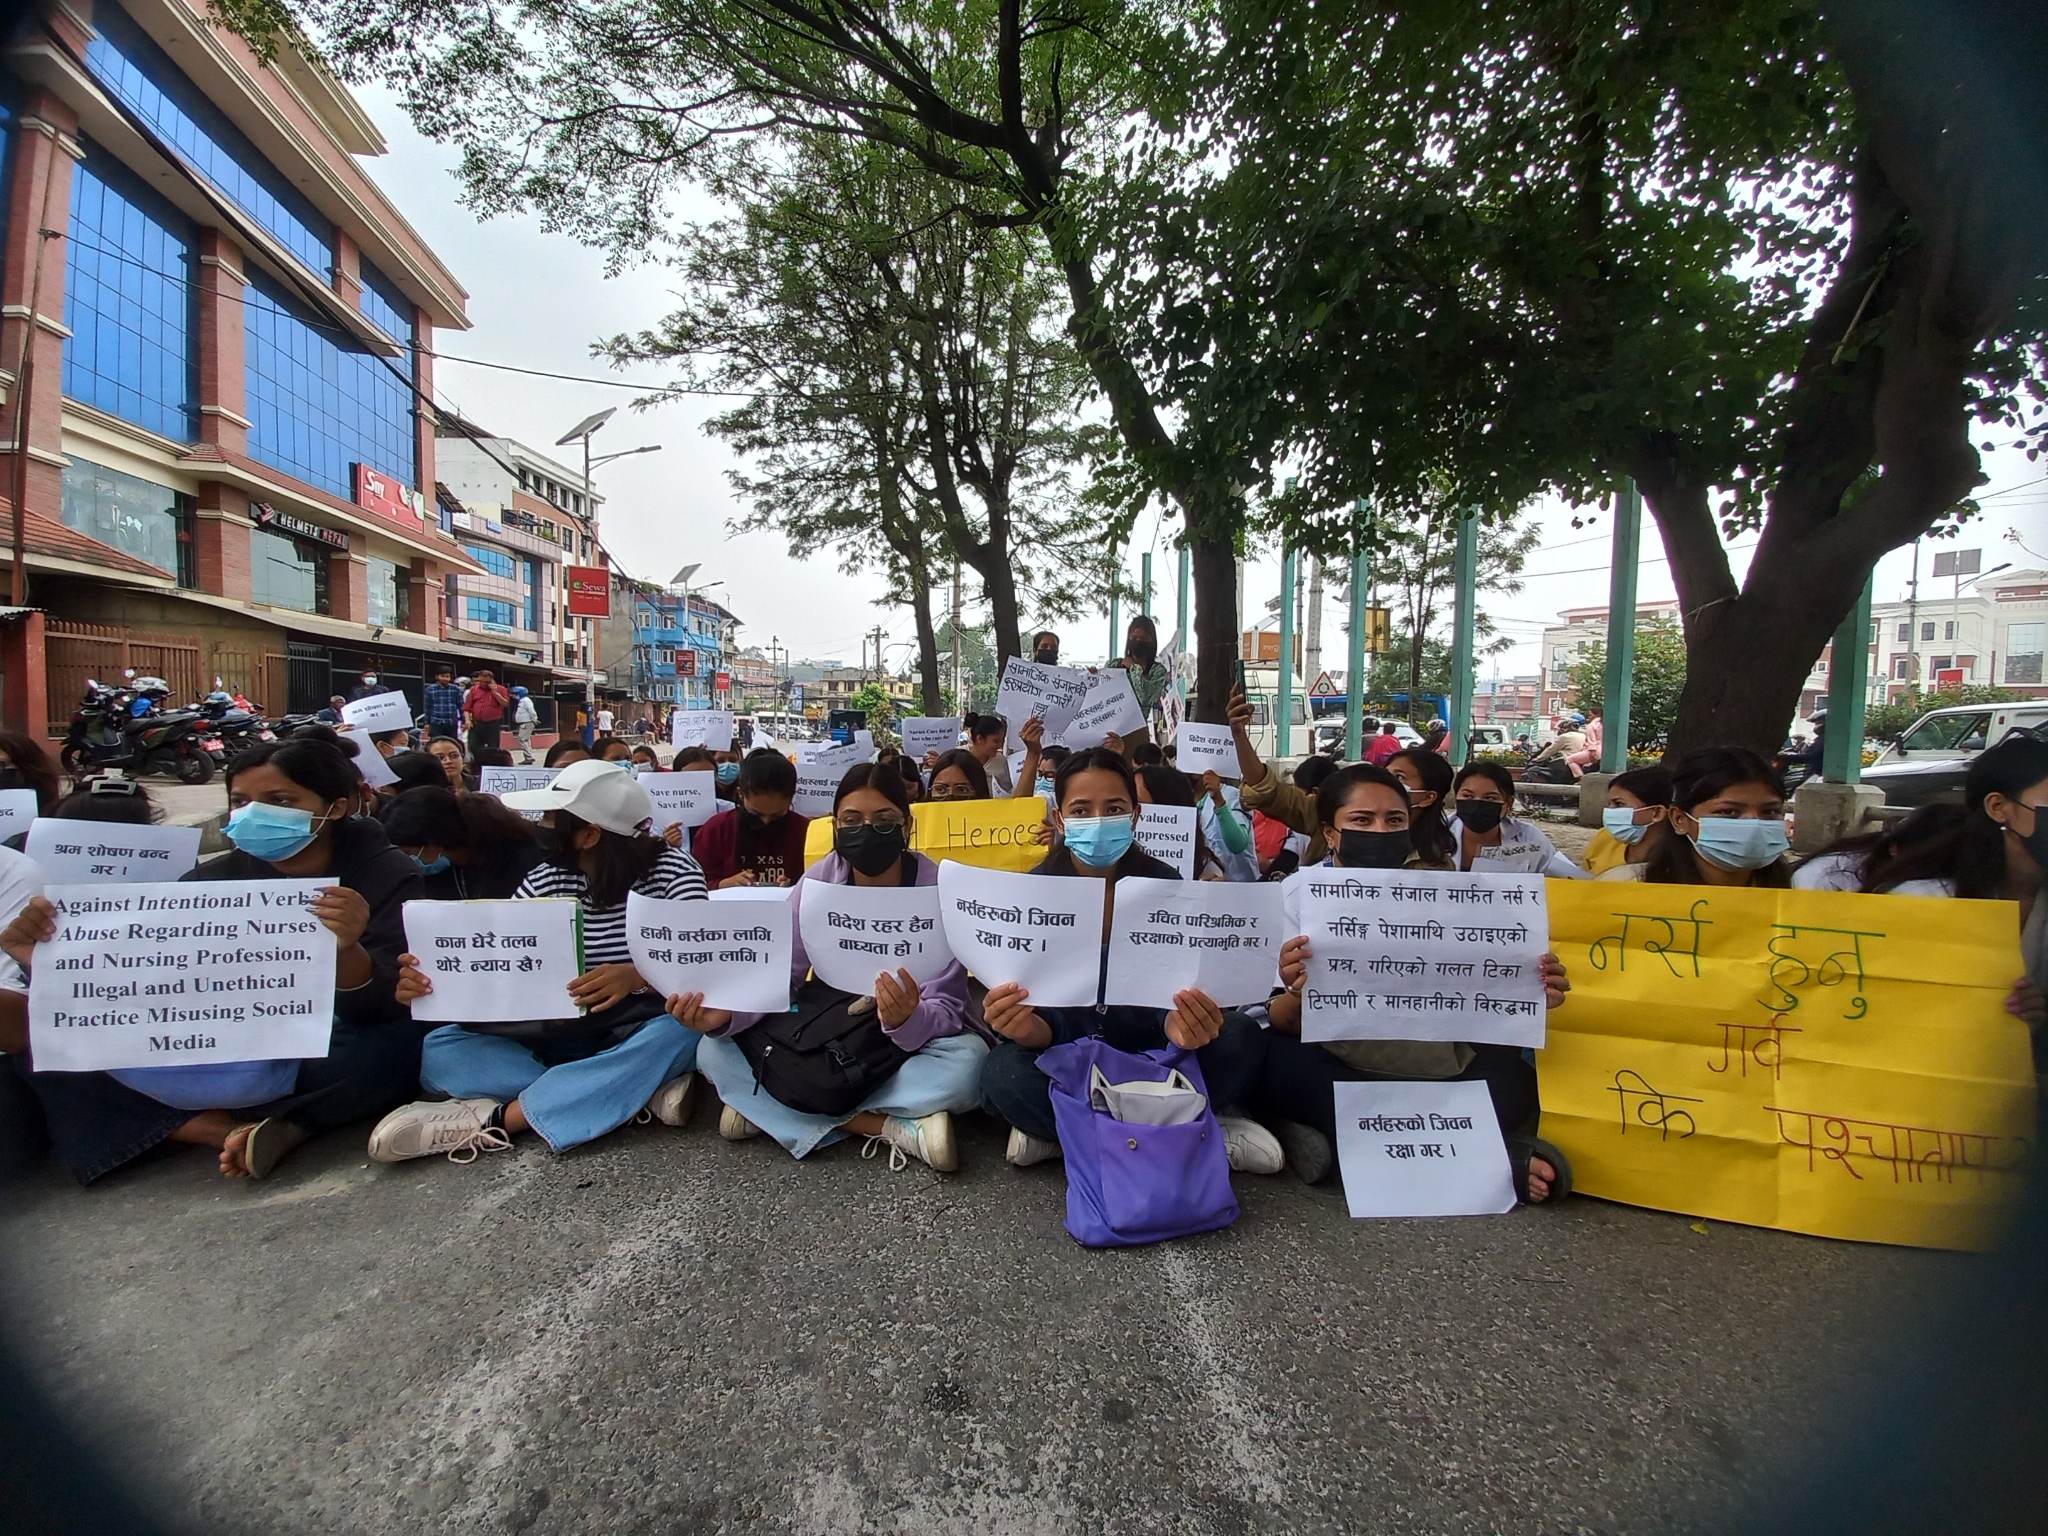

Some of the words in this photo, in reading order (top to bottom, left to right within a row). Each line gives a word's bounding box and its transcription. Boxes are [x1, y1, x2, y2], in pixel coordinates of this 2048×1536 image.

[280, 511, 319, 538] HELMETS
[650, 788, 670, 796] Save
[657, 801, 678, 809] Save
[680, 800, 695, 809] life
[1139, 812, 1178, 825] valued
[947, 817, 1042, 852] Heroes
[54, 844, 83, 856] श्रम
[88, 844, 135, 858] शोषण
[138, 848, 171, 860] बन्द
[740, 855, 784, 864] TXAS
[90, 864, 116, 876] गर
[1308, 879, 1382, 900] सामाजिक
[1389, 882, 1439, 904] संजाल
[1447, 884, 1495, 905] मार्फत
[1500, 884, 1524, 906] नर्स
[1529, 890, 1542, 906] र
[54, 896, 130, 917] Against
[138, 891, 251, 911] Intentional
[259, 890, 327, 907] Verb
[827, 911, 867, 931] विदेश
[871, 919, 904, 933] रहर
[908, 914, 935, 933] हैन
[1027, 907, 1076, 928] जिवन
[1147, 909, 1181, 926] उचित
[1185, 913, 1248, 929] पारिश्रमिक
[1250, 916, 1259, 929] र
[58, 925, 119, 941] Abuse
[127, 920, 239, 944] Regarding
[246, 918, 317, 936] Nurses
[640, 926, 673, 942] हामी
[678, 928, 729, 942] नर्सका
[975, 928, 1002, 948] रक्षा
[1007, 937, 1034, 953] गर
[1129, 931, 1185, 946] सुरक्षाको
[1242, 936, 1260, 949] गर
[1378, 918, 1445, 941] पेशामाथि
[1452, 922, 1528, 947] उठाइएको
[1588, 899, 1714, 978] नर्स
[434, 936, 467, 949] काम
[500, 935, 538, 949] तलब
[893, 939, 912, 957] हो
[55, 953, 95, 970] and
[103, 950, 188, 971] Nursing
[196, 947, 312, 966] Profession,
[470, 959, 511, 972] न्याय
[648, 948, 673, 963] नर्स
[677, 951, 714, 965] हाम्रा
[719, 947, 758, 963] लागि
[1367, 955, 1428, 977] गरिएको
[1435, 963, 1475, 979] गलत
[1483, 959, 1523, 979] टिका
[71, 979, 138, 1002] Illegal
[144, 977, 186, 996] and
[193, 973, 296, 994] Unethical
[1308, 989, 1358, 1011] टिप्पणी
[1365, 994, 1378, 1011] र
[1383, 991, 1466, 1013] मानहानीको
[1475, 995, 1539, 1017] विरुद्धमा
[53, 1009, 139, 1028] Practice
[146, 1003, 246, 1025] Misusing
[252, 1000, 313, 1018] Social
[149, 1034, 217, 1052] Media
[1605, 1069, 1704, 1142] कि
[1358, 1113, 1426, 1133] नर्सहरुको
[1429, 1112, 1473, 1131] जिवन
[1384, 1143, 1416, 1160] रक्षा
[1419, 1143, 1444, 1158] गर
